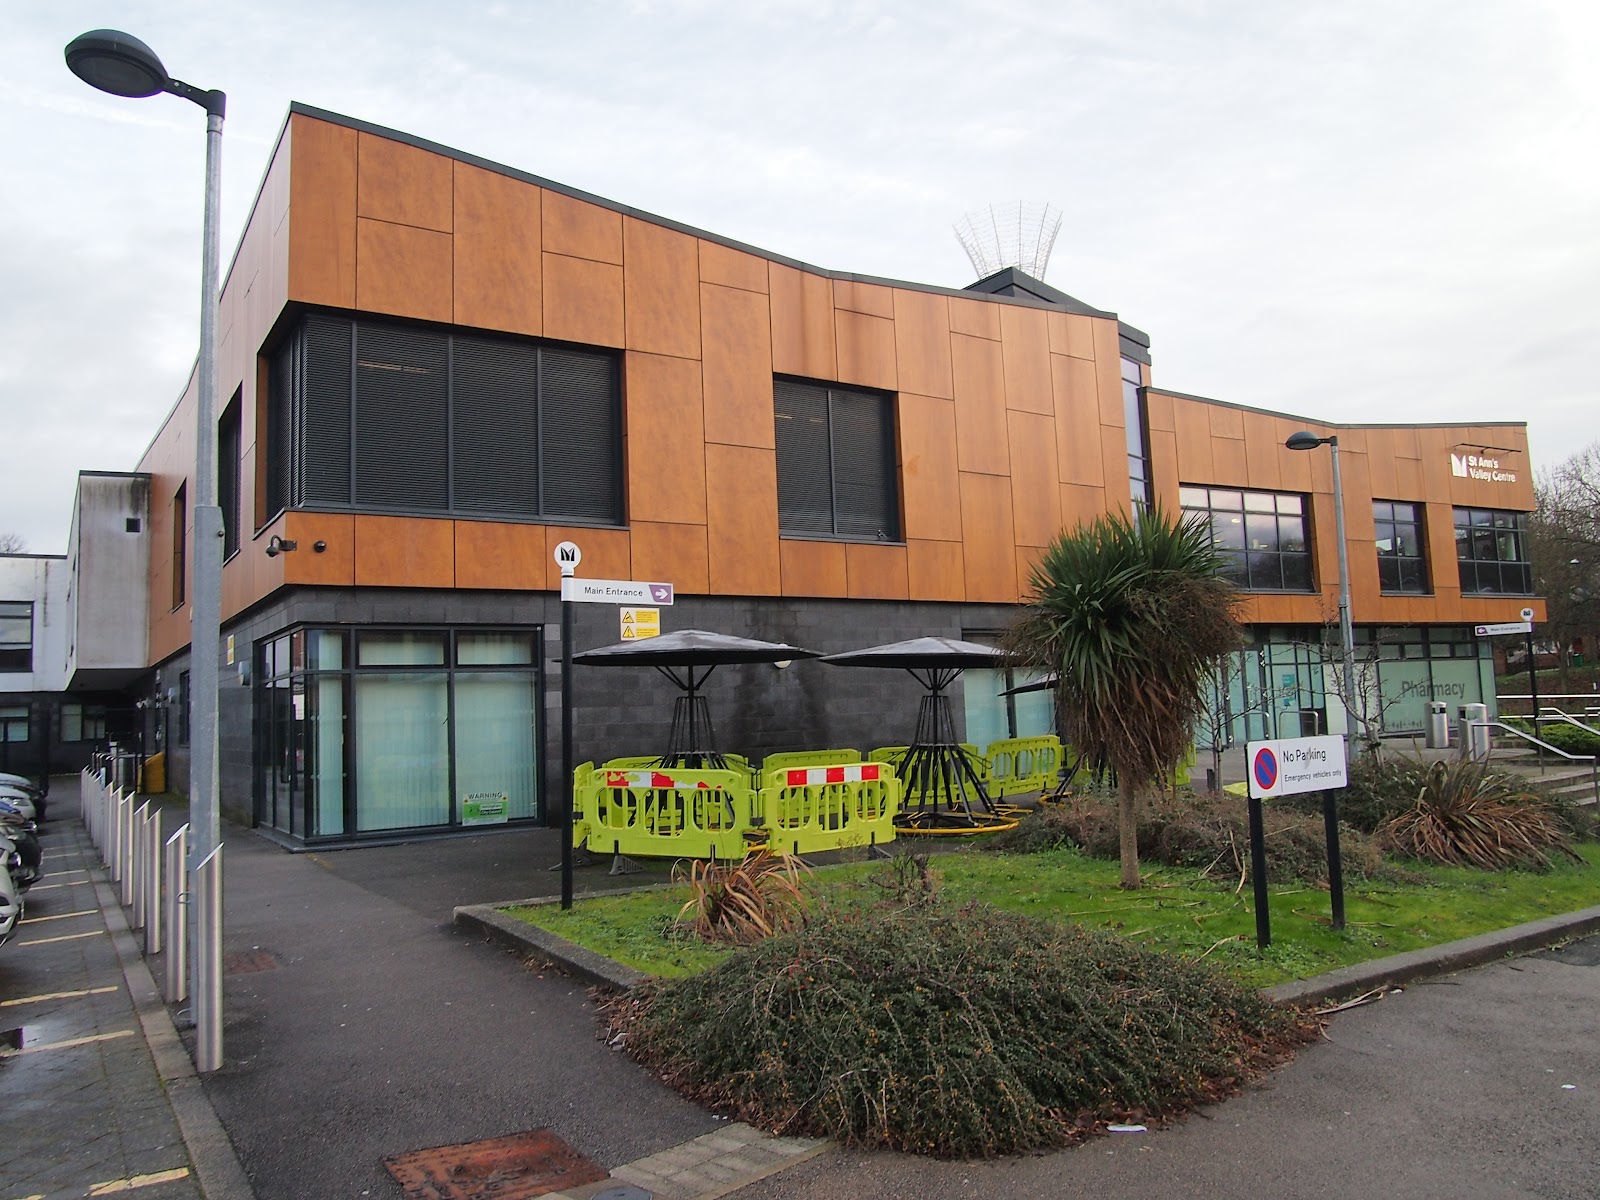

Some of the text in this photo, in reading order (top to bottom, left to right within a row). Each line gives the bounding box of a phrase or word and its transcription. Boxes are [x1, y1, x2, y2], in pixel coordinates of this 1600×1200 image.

[1468, 455, 1499, 469] St Ann's
[1469, 468, 1516, 482] Valley Centre
[584, 586, 643, 597] Main Entrance
[1401, 680, 1465, 699] Pharmacy
[1283, 748, 1327, 763] No Parking
[1285, 769, 1342, 783] Emergency vehicles only
